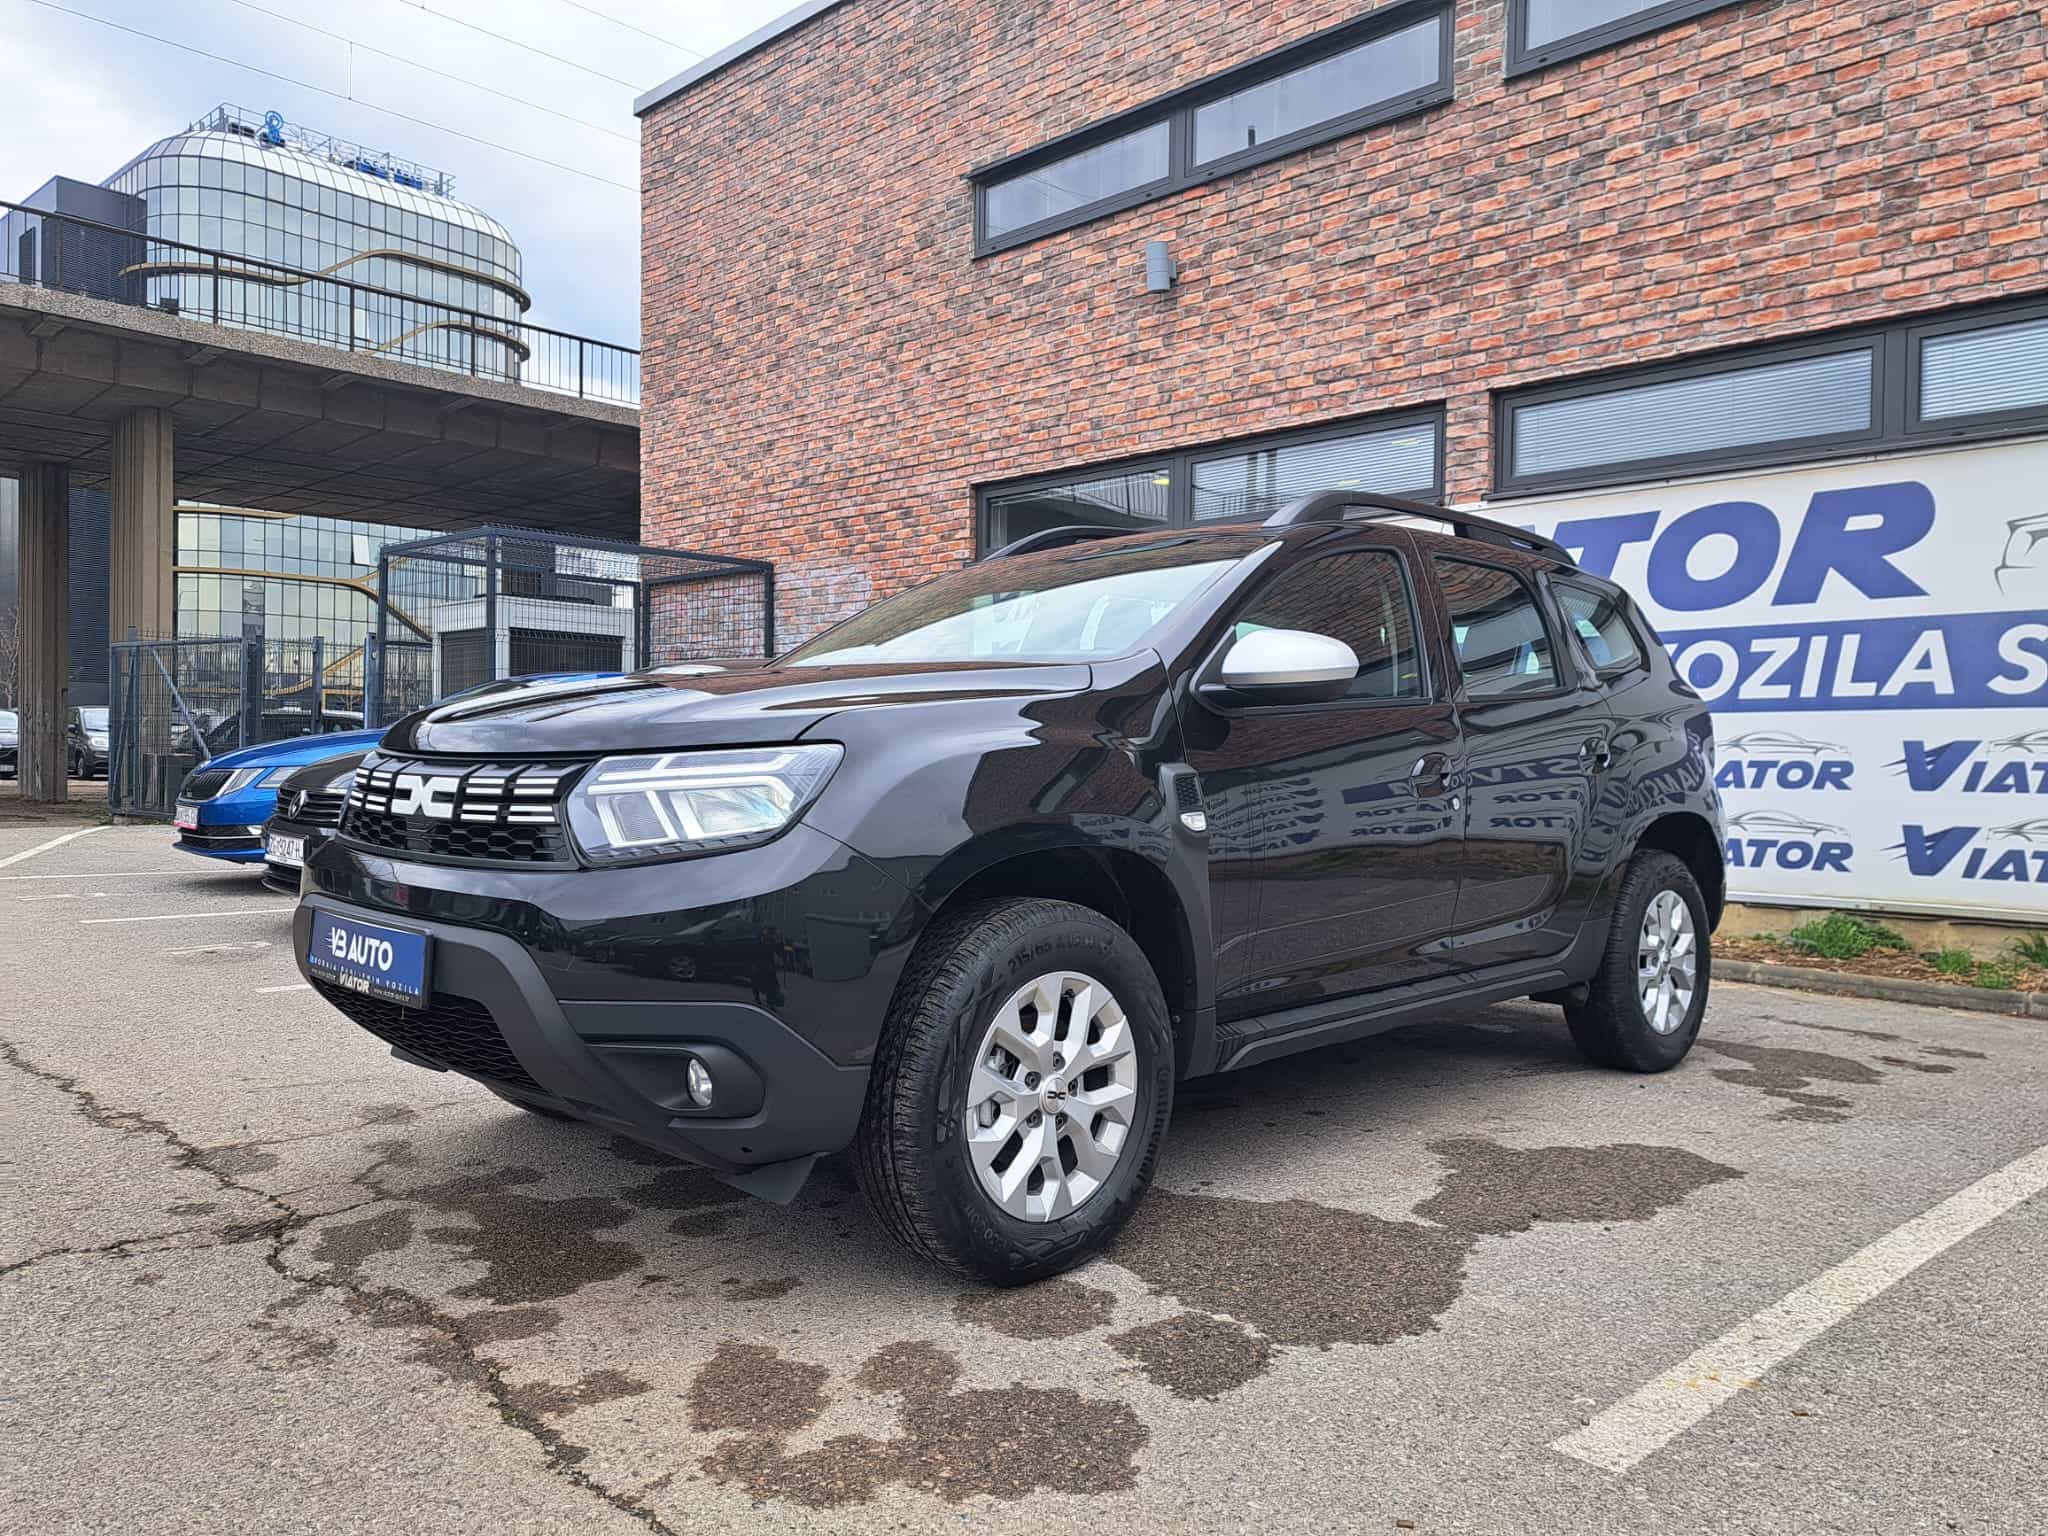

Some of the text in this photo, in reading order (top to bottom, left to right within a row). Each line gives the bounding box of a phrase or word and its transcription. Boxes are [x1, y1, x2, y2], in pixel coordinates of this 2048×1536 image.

[1663, 630, 1956, 702] OZILA
[1713, 760, 1855, 790] ATOR
[347, 933, 393, 972] AUTO
[339, 971, 370, 993] VIATOR
